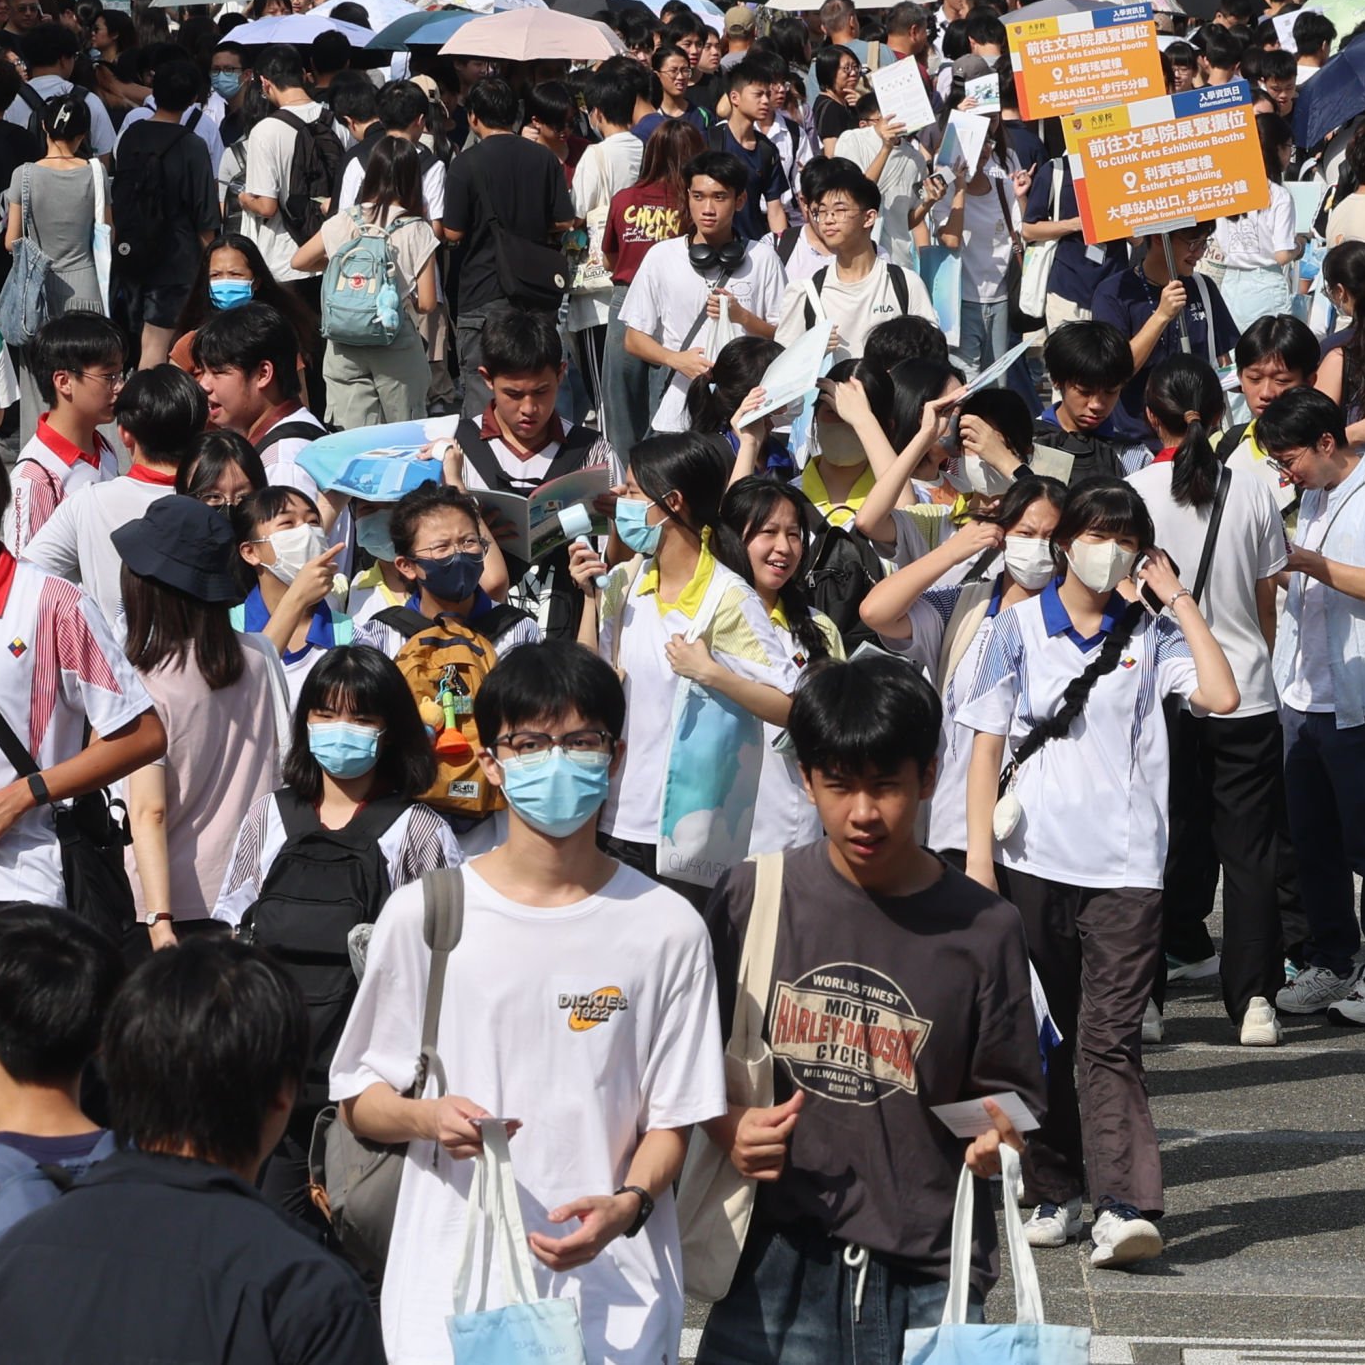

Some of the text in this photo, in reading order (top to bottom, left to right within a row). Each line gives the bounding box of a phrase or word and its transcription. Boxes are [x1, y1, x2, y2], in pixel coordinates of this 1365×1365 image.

[1026, 25, 1150, 56] 前往文學院展覽攤位
[1032, 41, 1148, 65] To CUHK Arts Exhibition Booths
[1065, 68, 1129, 84] Esther Lee Building
[1199, 86, 1240, 102] 入學資訊日
[1199, 95, 1243, 108] Information Day
[1088, 110, 1247, 158] 前往文學院展覽攤位
[1096, 132, 1245, 169] To CUHK Arts Exhibition Booths
[1140, 168, 1222, 193] Esther Lee Building
[1123, 216, 1143, 226] 5-min
[1143, 213, 1159, 223] walk
[1160, 210, 1176, 219] from
[1176, 206, 1192, 216] MTR
[1193, 202, 1216, 214] station
[1217, 198, 1229, 207] Exit
[558, 993, 629, 1010] DICKIES
[813, 974, 902, 1006] WORLDS FINEST
[576, 1006, 609, 1022] 1922
[824, 998, 880, 1025] MOTOR
[774, 994, 921, 1080] HARLEY-DAVIDSON
[816, 1044, 872, 1071] CYCLES
